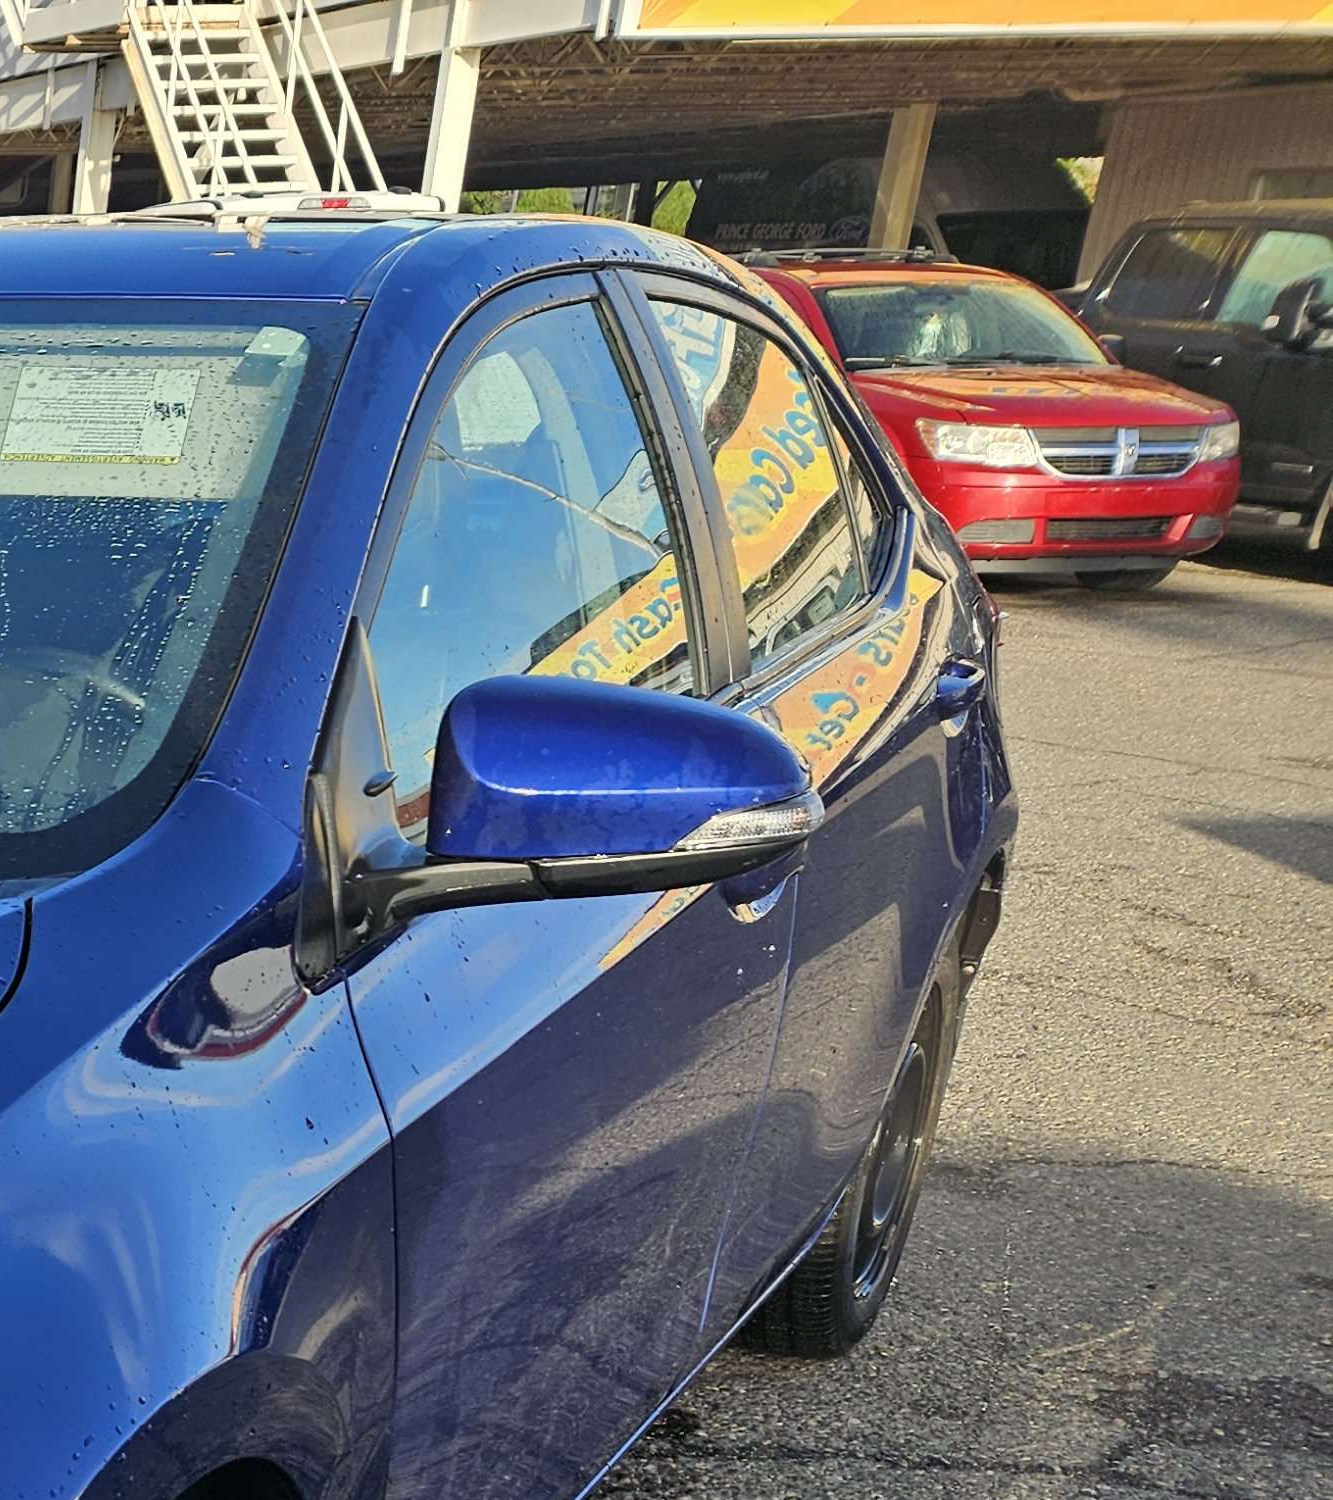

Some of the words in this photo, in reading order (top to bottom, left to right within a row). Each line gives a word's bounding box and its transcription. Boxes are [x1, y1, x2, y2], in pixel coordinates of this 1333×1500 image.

[714, 223, 751, 240] PRINCE
[752, 223, 796, 240] GEORGE
[797, 223, 827, 240] FORD
